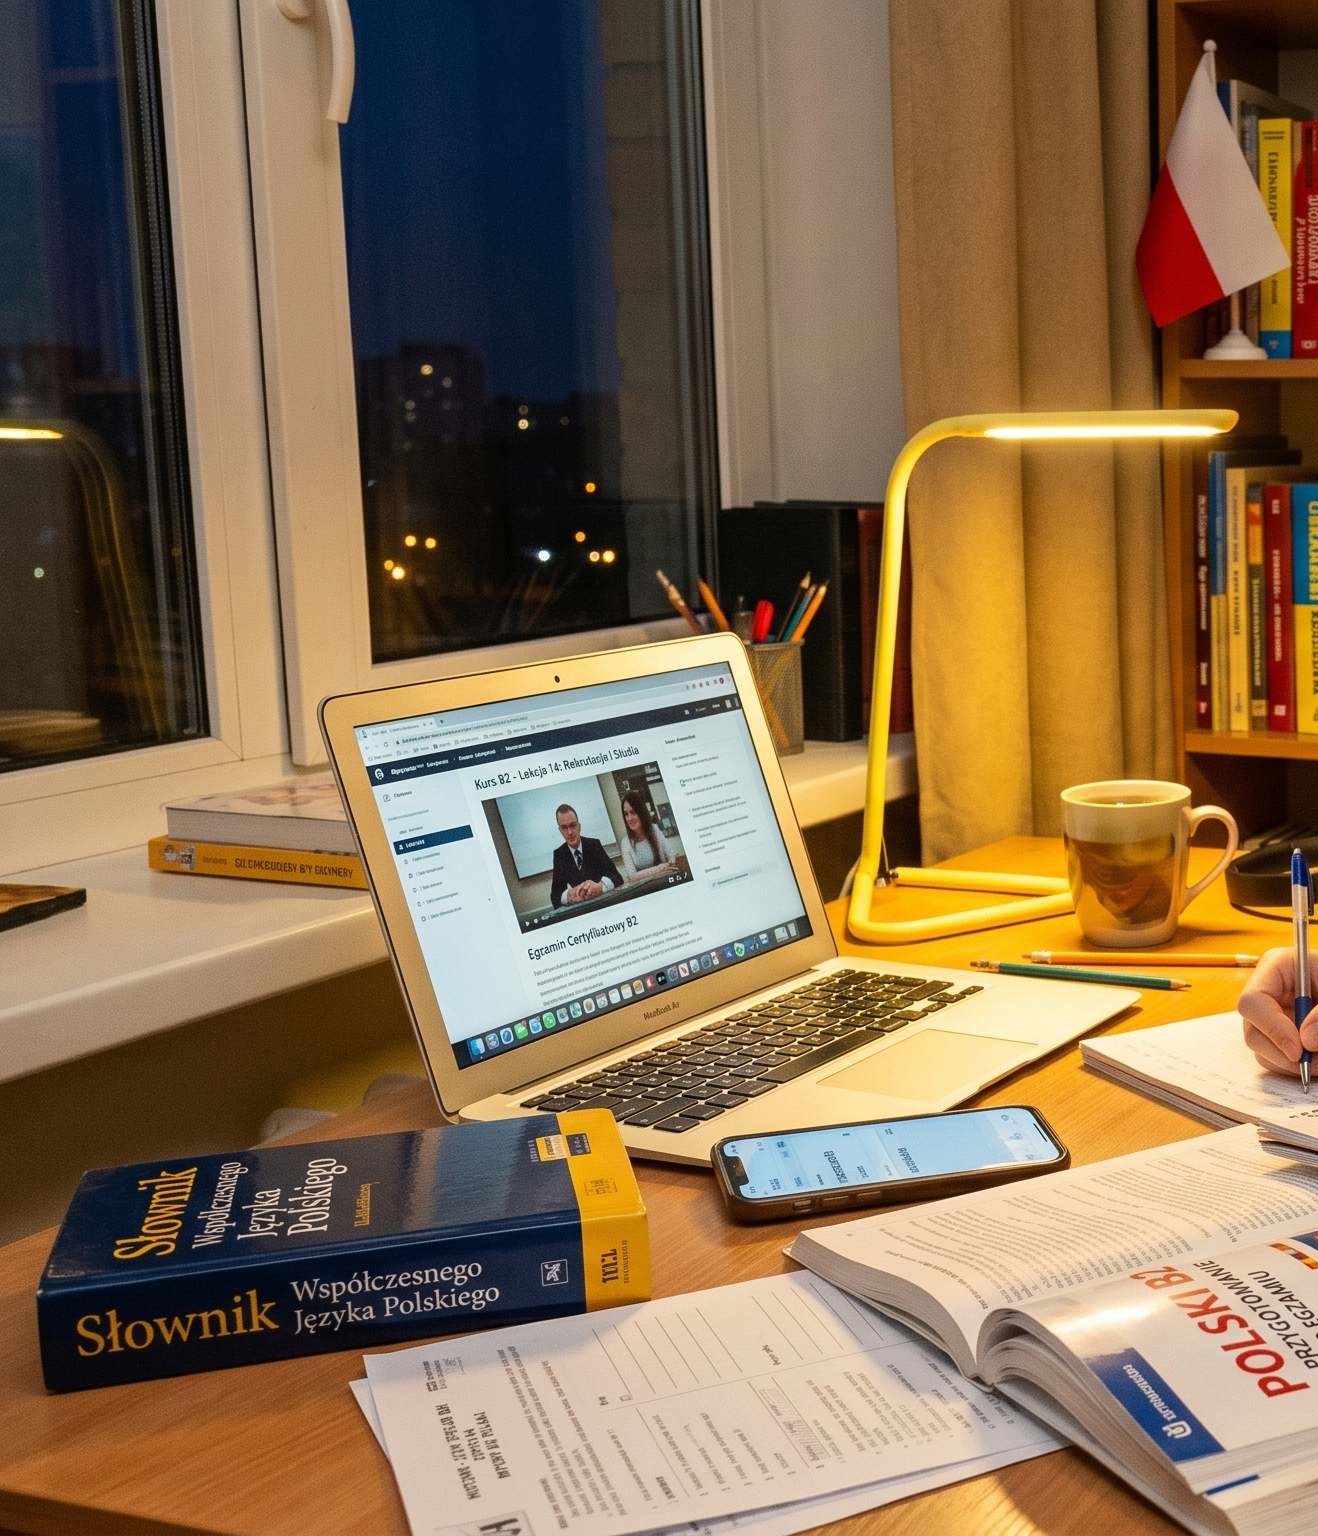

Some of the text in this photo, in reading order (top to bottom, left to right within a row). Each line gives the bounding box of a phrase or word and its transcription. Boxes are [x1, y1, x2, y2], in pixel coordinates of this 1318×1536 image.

[474, 777, 498, 791] Kurs
[498, 772, 512, 786] B2
[626, 915, 639, 928] B2
[290, 1261, 483, 1307] Współczesnego
[1129, 1266, 1195, 1290] B2
[75, 1289, 280, 1358] Słownik
[293, 1286, 500, 1336] Języka Polskiego
[1167, 1287, 1311, 1398] POLSKI
